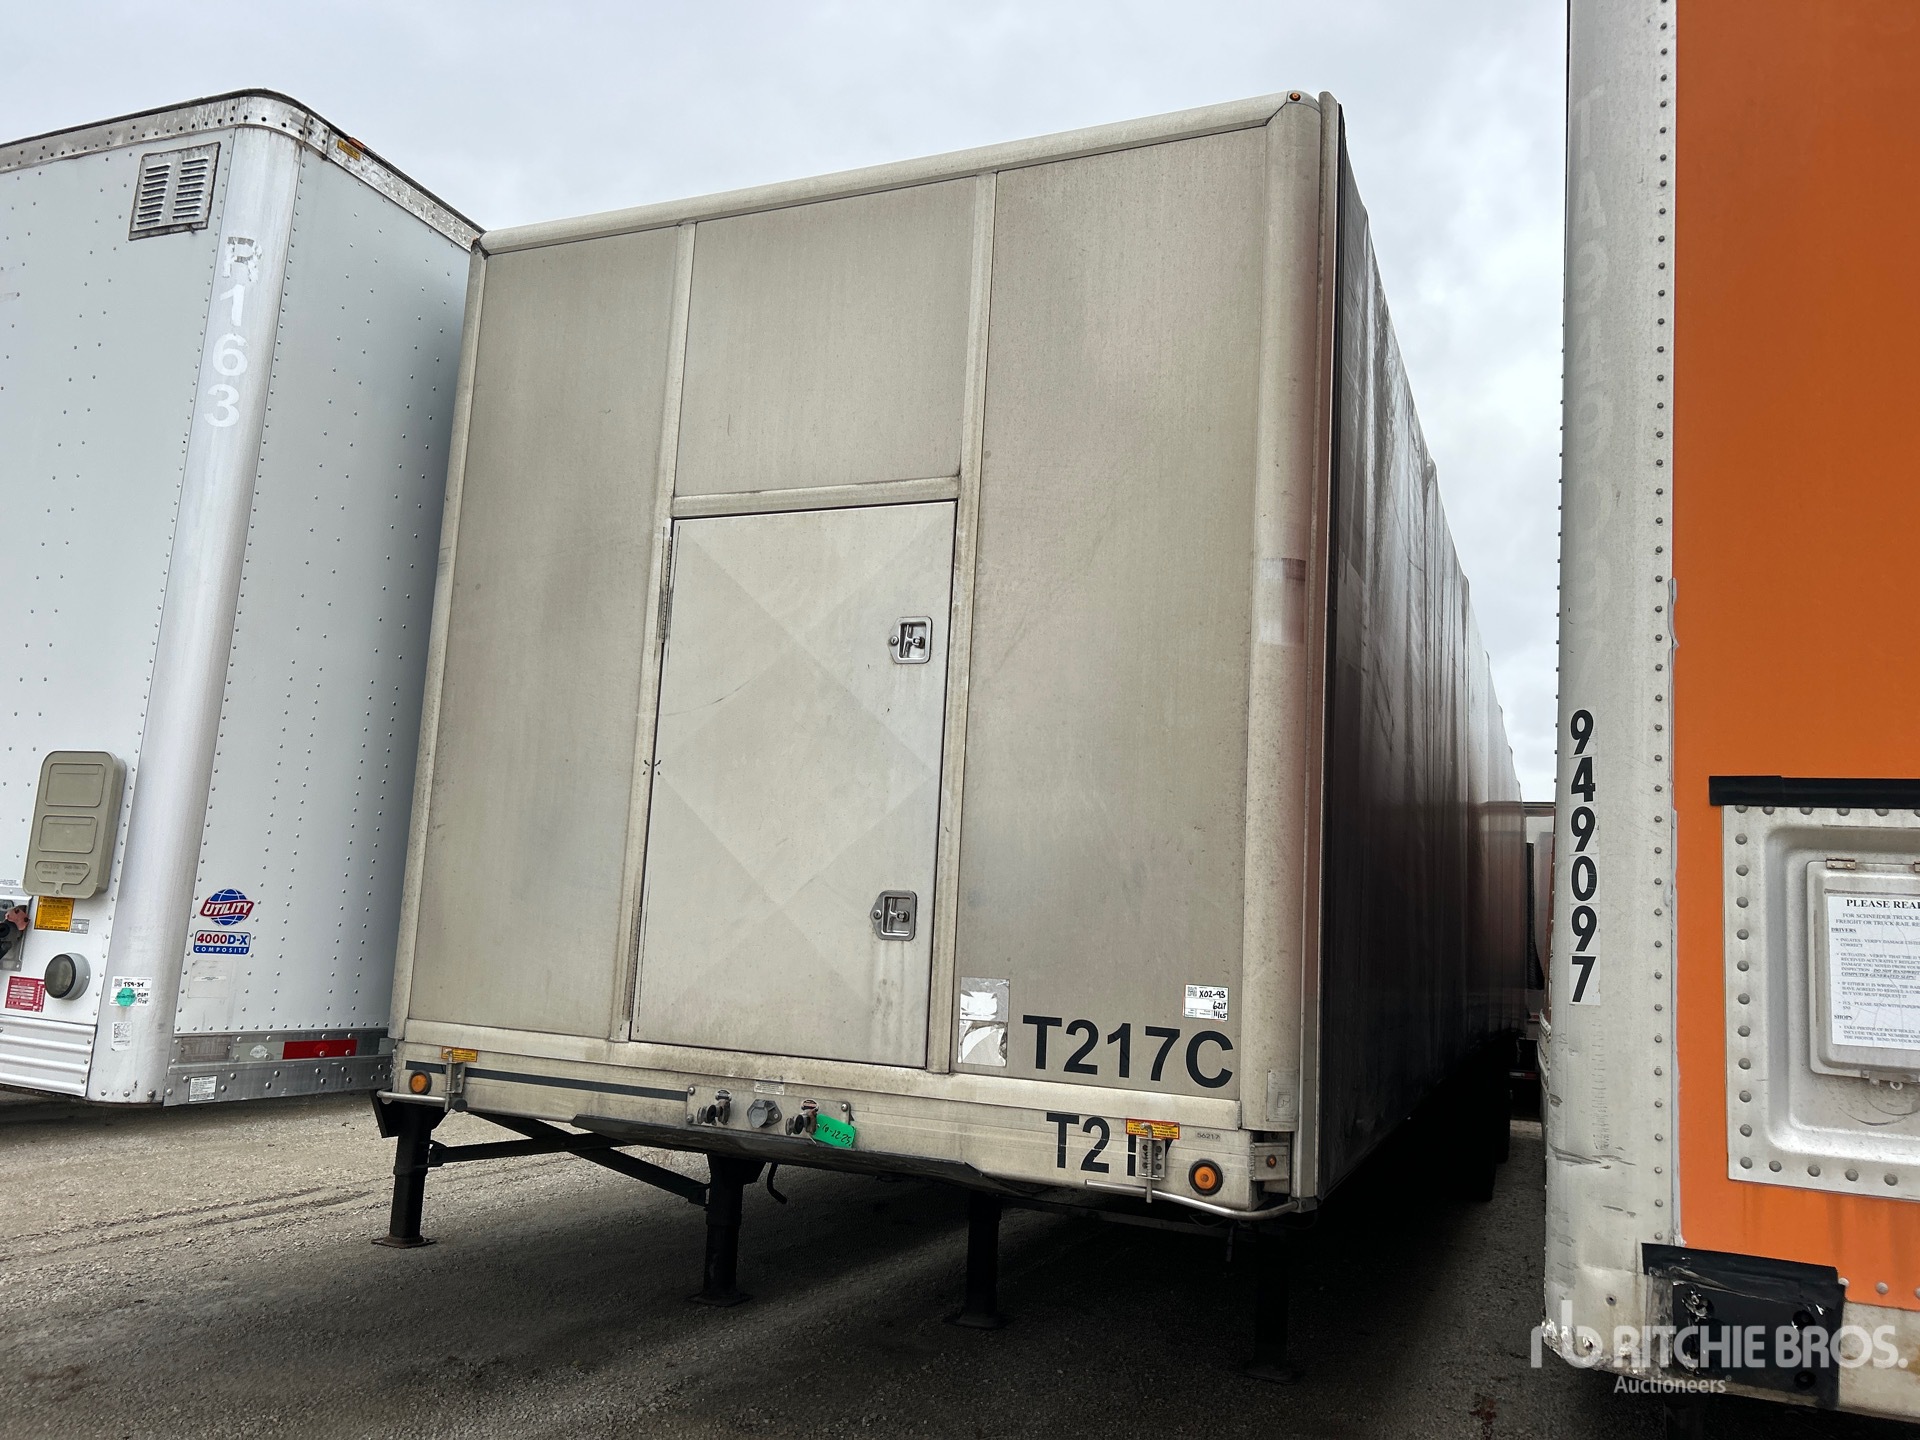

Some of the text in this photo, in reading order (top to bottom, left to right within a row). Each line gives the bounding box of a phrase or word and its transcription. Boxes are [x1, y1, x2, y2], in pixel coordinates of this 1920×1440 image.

[1570, 709, 1597, 1003] 949097
[203, 902, 252, 915] UTILITY
[1846, 899, 1890, 908] PLEASE
[197, 933, 248, 945] 4000D-X
[1022, 1014, 1234, 1089] T217C
